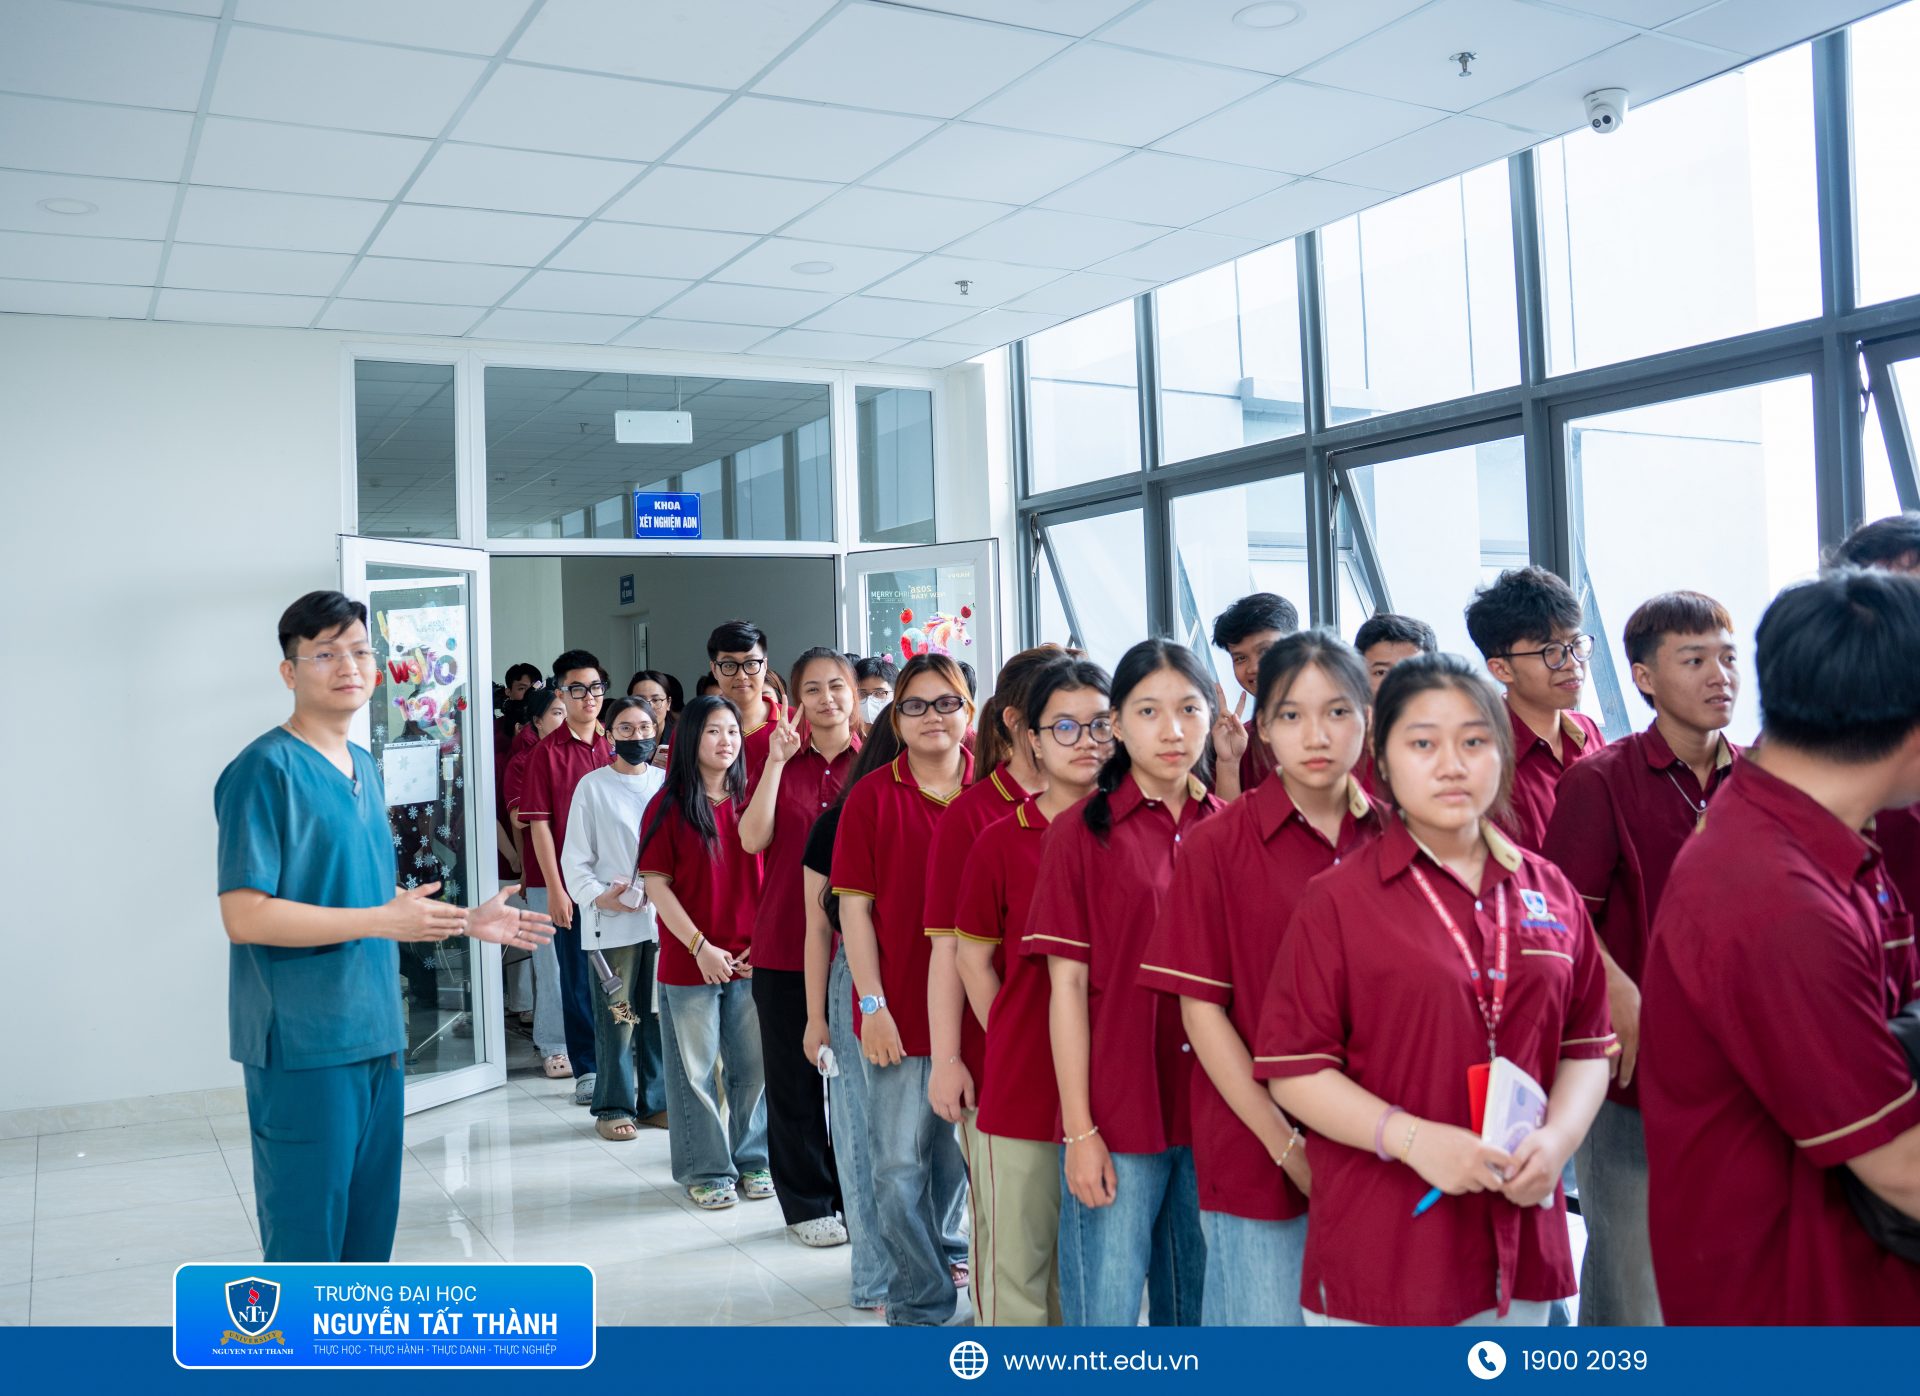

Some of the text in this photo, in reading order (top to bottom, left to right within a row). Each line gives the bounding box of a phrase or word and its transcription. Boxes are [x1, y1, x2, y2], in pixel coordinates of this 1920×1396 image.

[654, 501, 681, 510] KHOA
[639, 513, 698, 531] XÉT NGHIỆM ADN
[871, 590, 912, 598] MERRY CHRI
